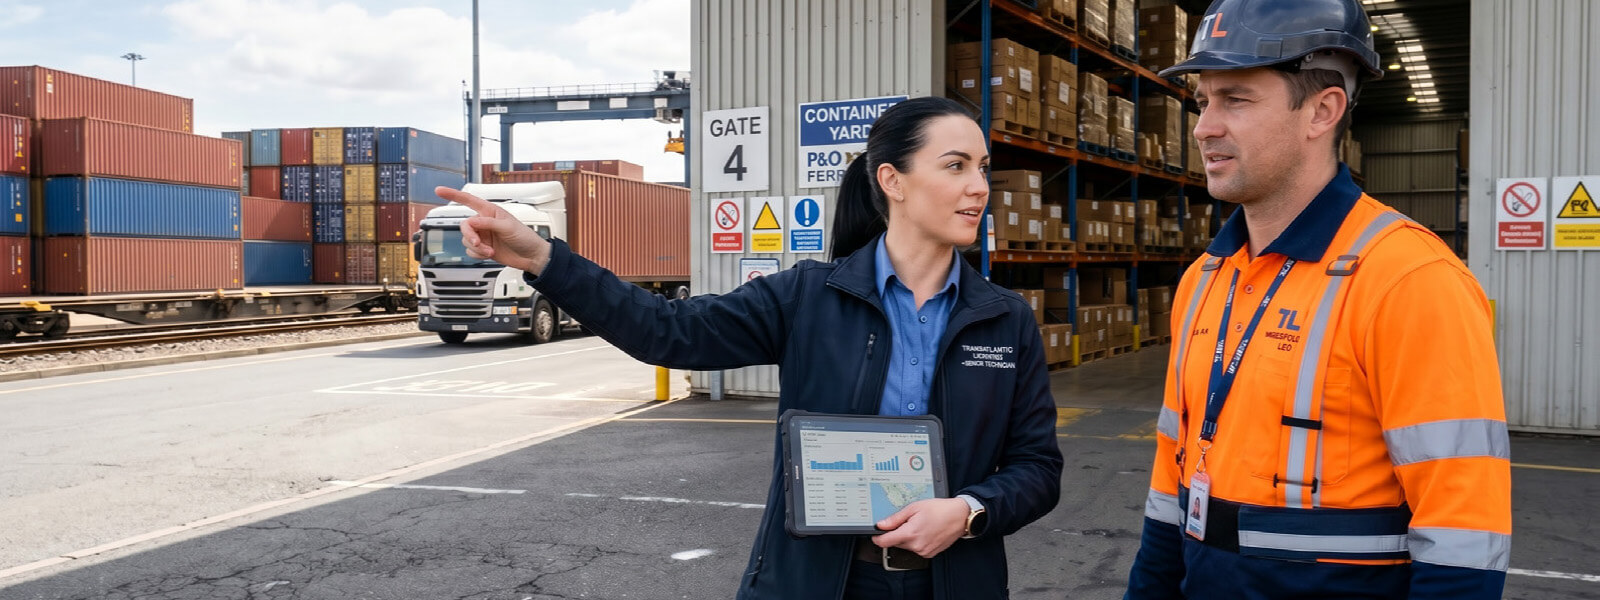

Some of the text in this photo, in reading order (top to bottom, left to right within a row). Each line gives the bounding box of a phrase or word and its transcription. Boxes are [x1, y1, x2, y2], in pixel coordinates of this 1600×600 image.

[1201, 13, 1228, 40] TL
[805, 102, 897, 123] CONTAINE
[710, 117, 761, 137] GATE
[724, 145, 747, 181] 4
[807, 151, 842, 167] P&O
[807, 170, 846, 182] FERR
